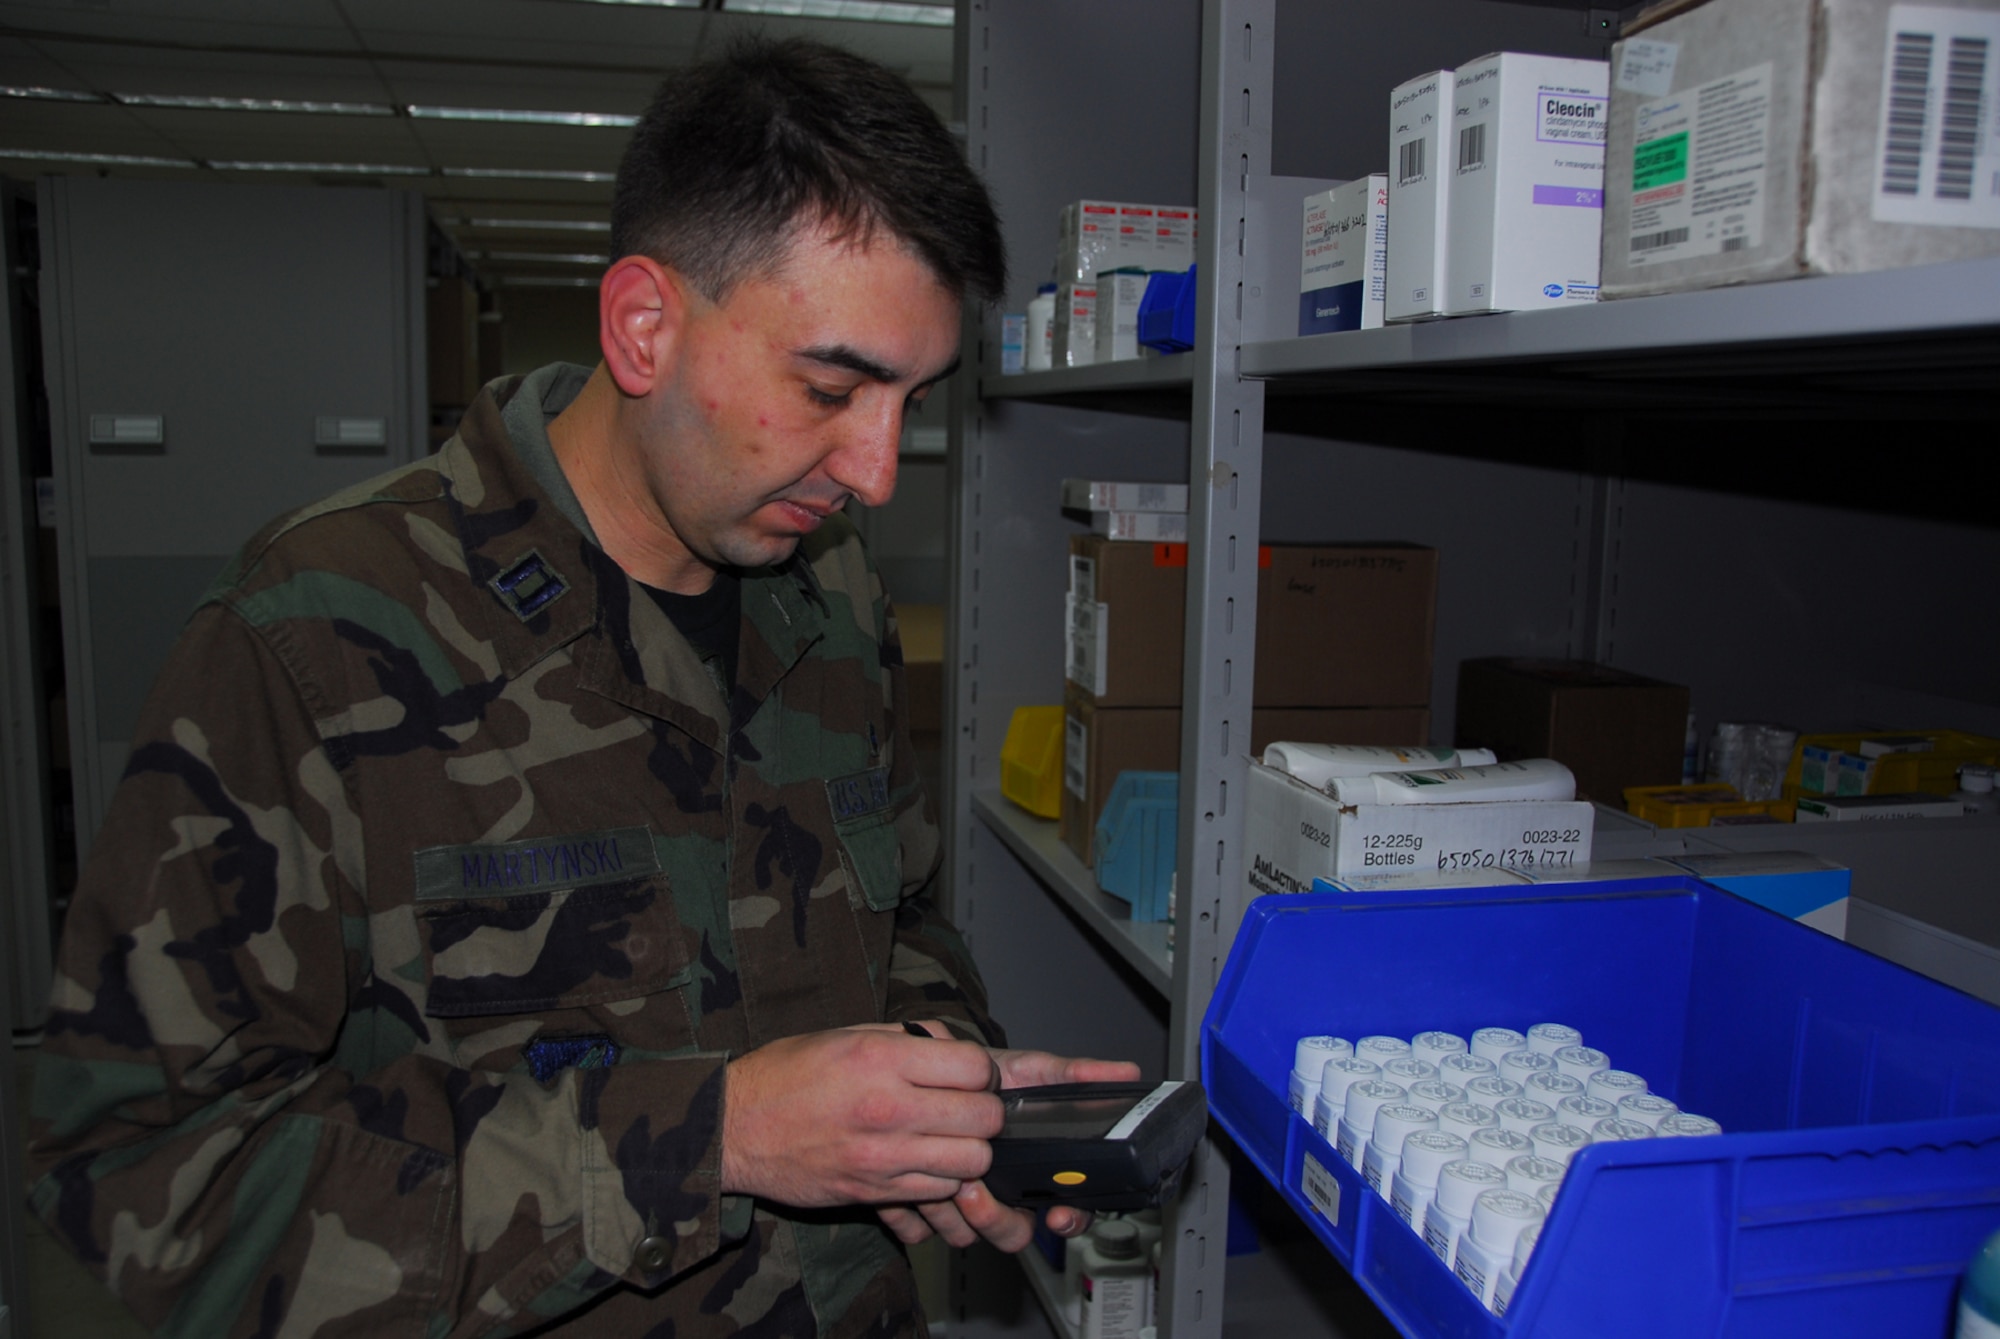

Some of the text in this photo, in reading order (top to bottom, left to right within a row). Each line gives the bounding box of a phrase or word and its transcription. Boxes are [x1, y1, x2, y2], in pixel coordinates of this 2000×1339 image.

[1544, 127, 1569, 139] vaginal
[1300, 821, 1332, 849] 0023-22
[1362, 834, 1423, 851] 12-225g
[1522, 829, 1580, 844] 0023-22
[460, 837, 625, 889] MARTYNSKI
[1364, 851, 1415, 866] Bottles
